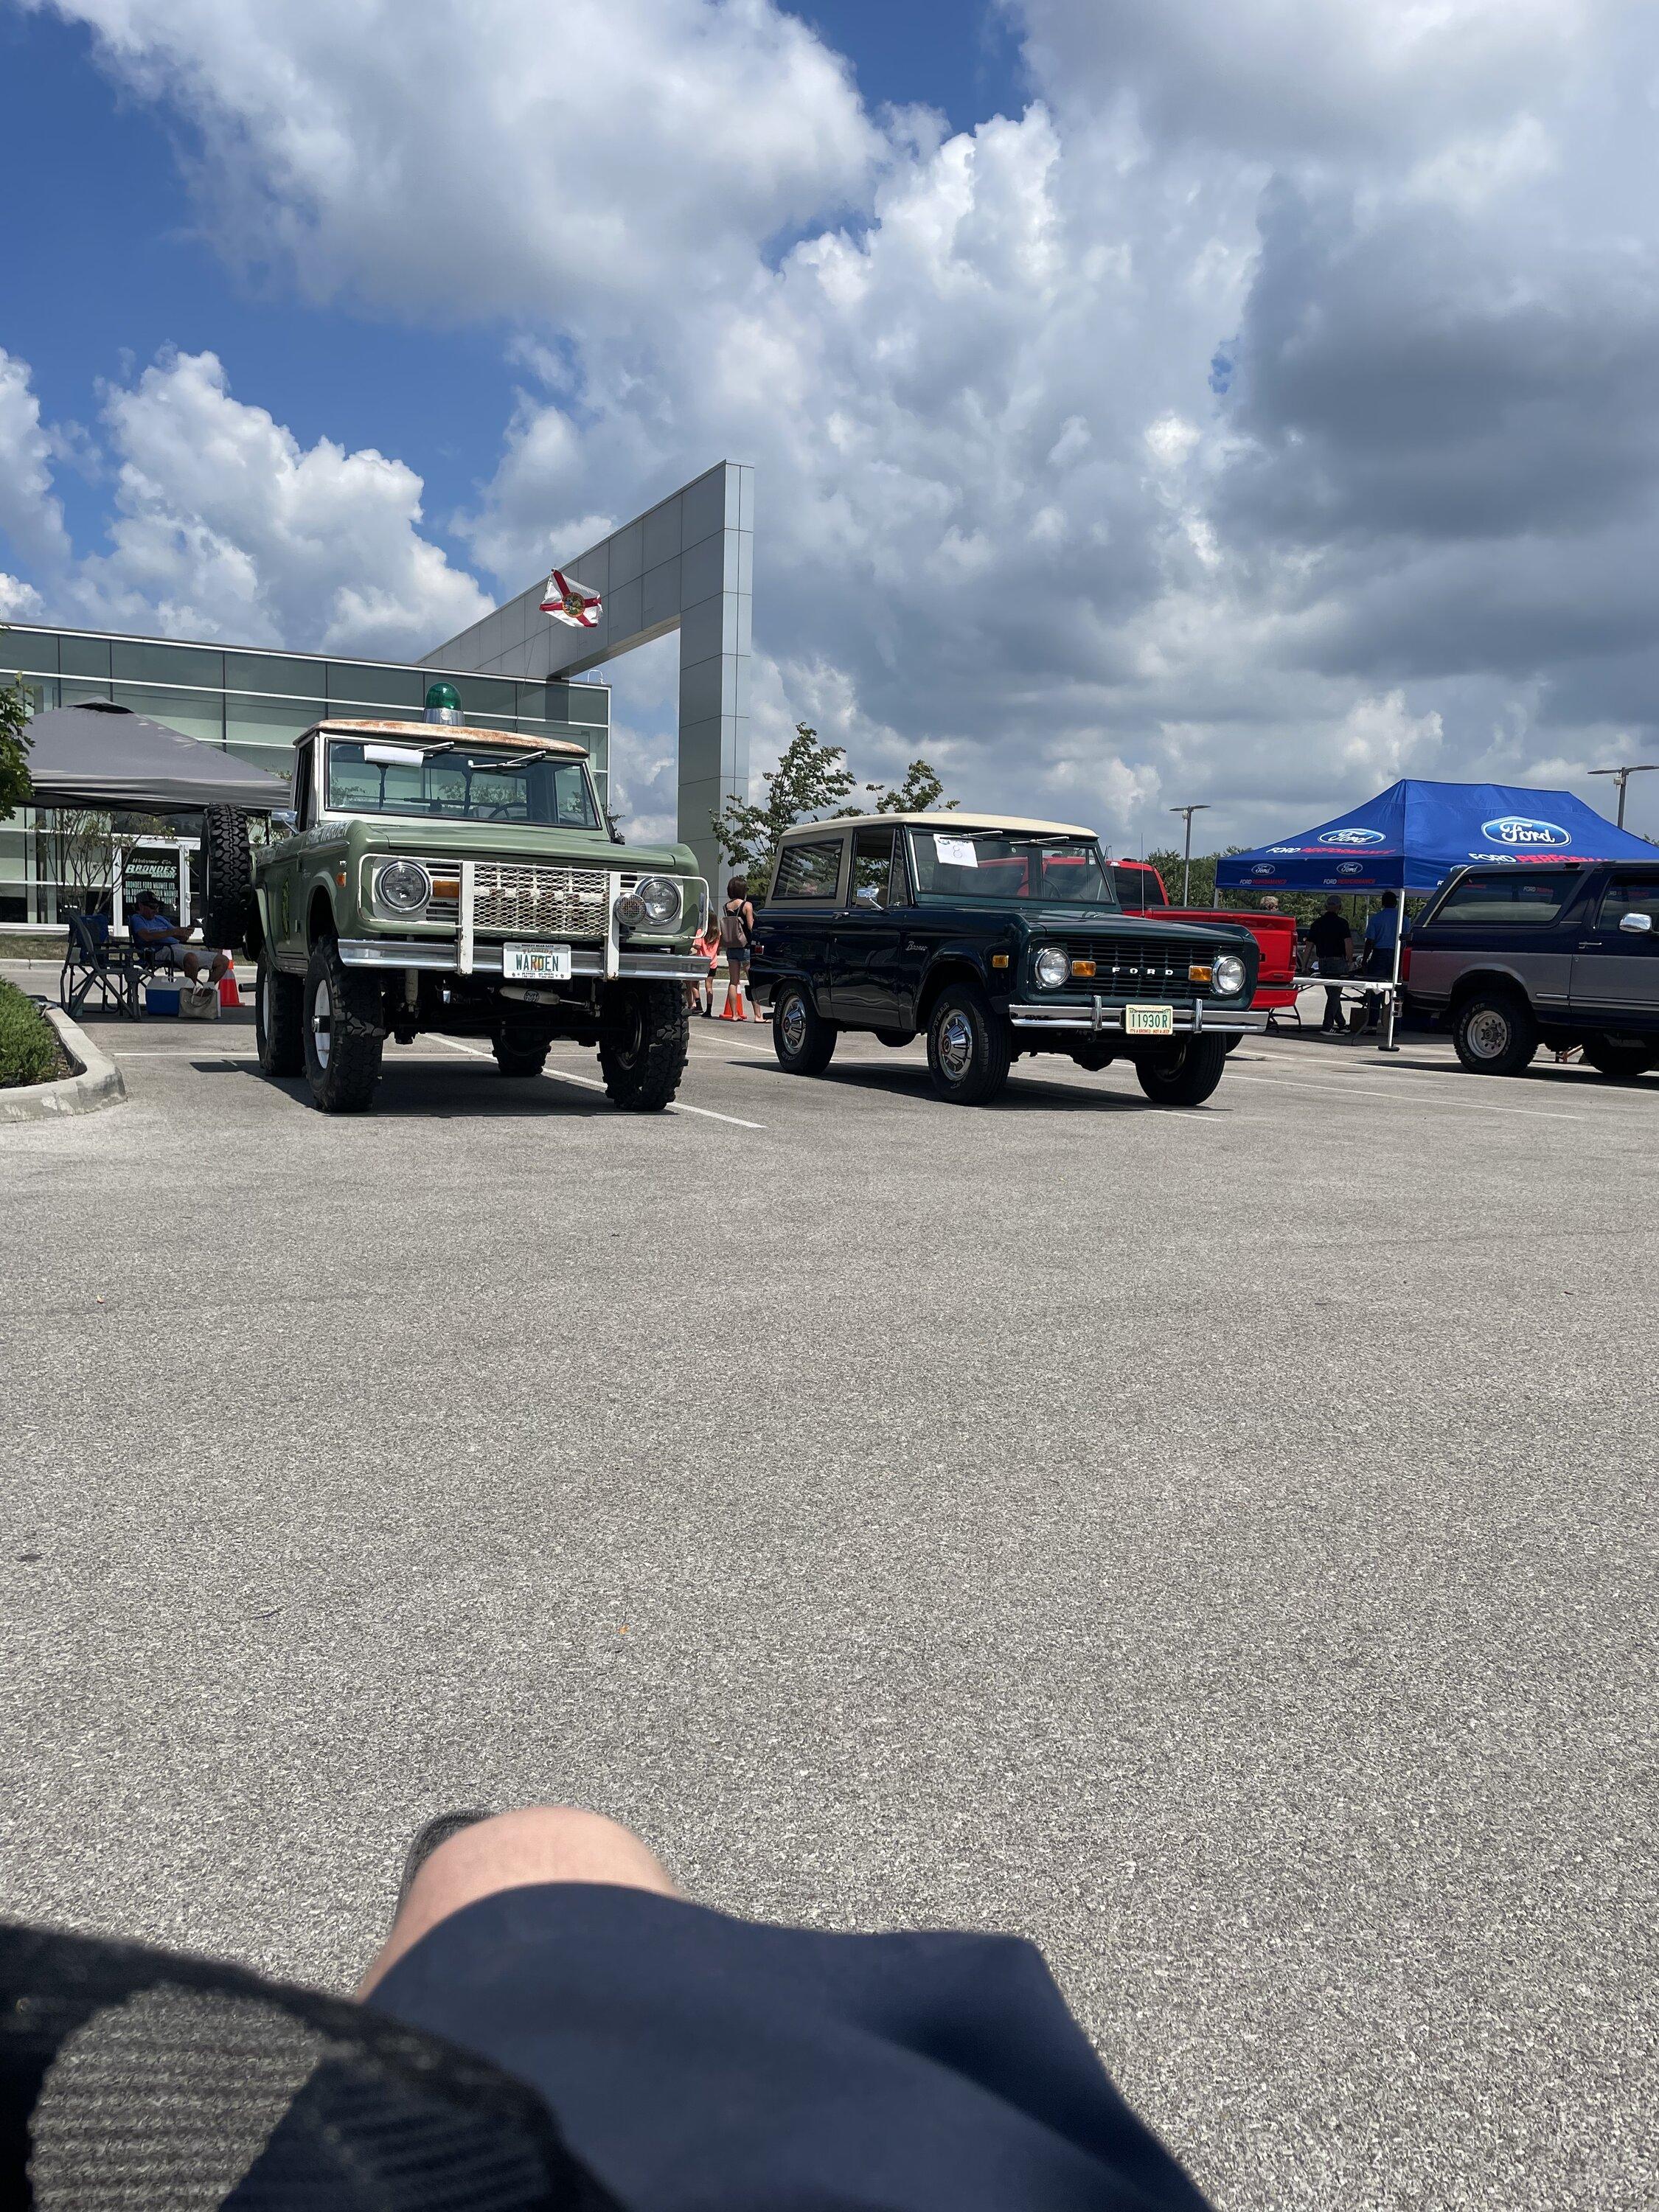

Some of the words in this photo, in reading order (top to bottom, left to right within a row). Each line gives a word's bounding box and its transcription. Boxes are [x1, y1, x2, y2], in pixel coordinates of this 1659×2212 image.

[1328, 831, 1374, 843] Ford
[1499, 822, 1556, 844] Ford
[953, 845, 962, 858] 8
[1468, 852, 1517, 863] FORD
[125, 864, 177, 874] BRONDES
[1255, 865, 1272, 874] Ford
[1341, 863, 1358, 872] Ford
[142, 881, 152, 889] FORD
[905, 941, 928, 950] Bronco
[516, 954, 559, 972] WARDEN
[1112, 967, 1174, 975] FORD
